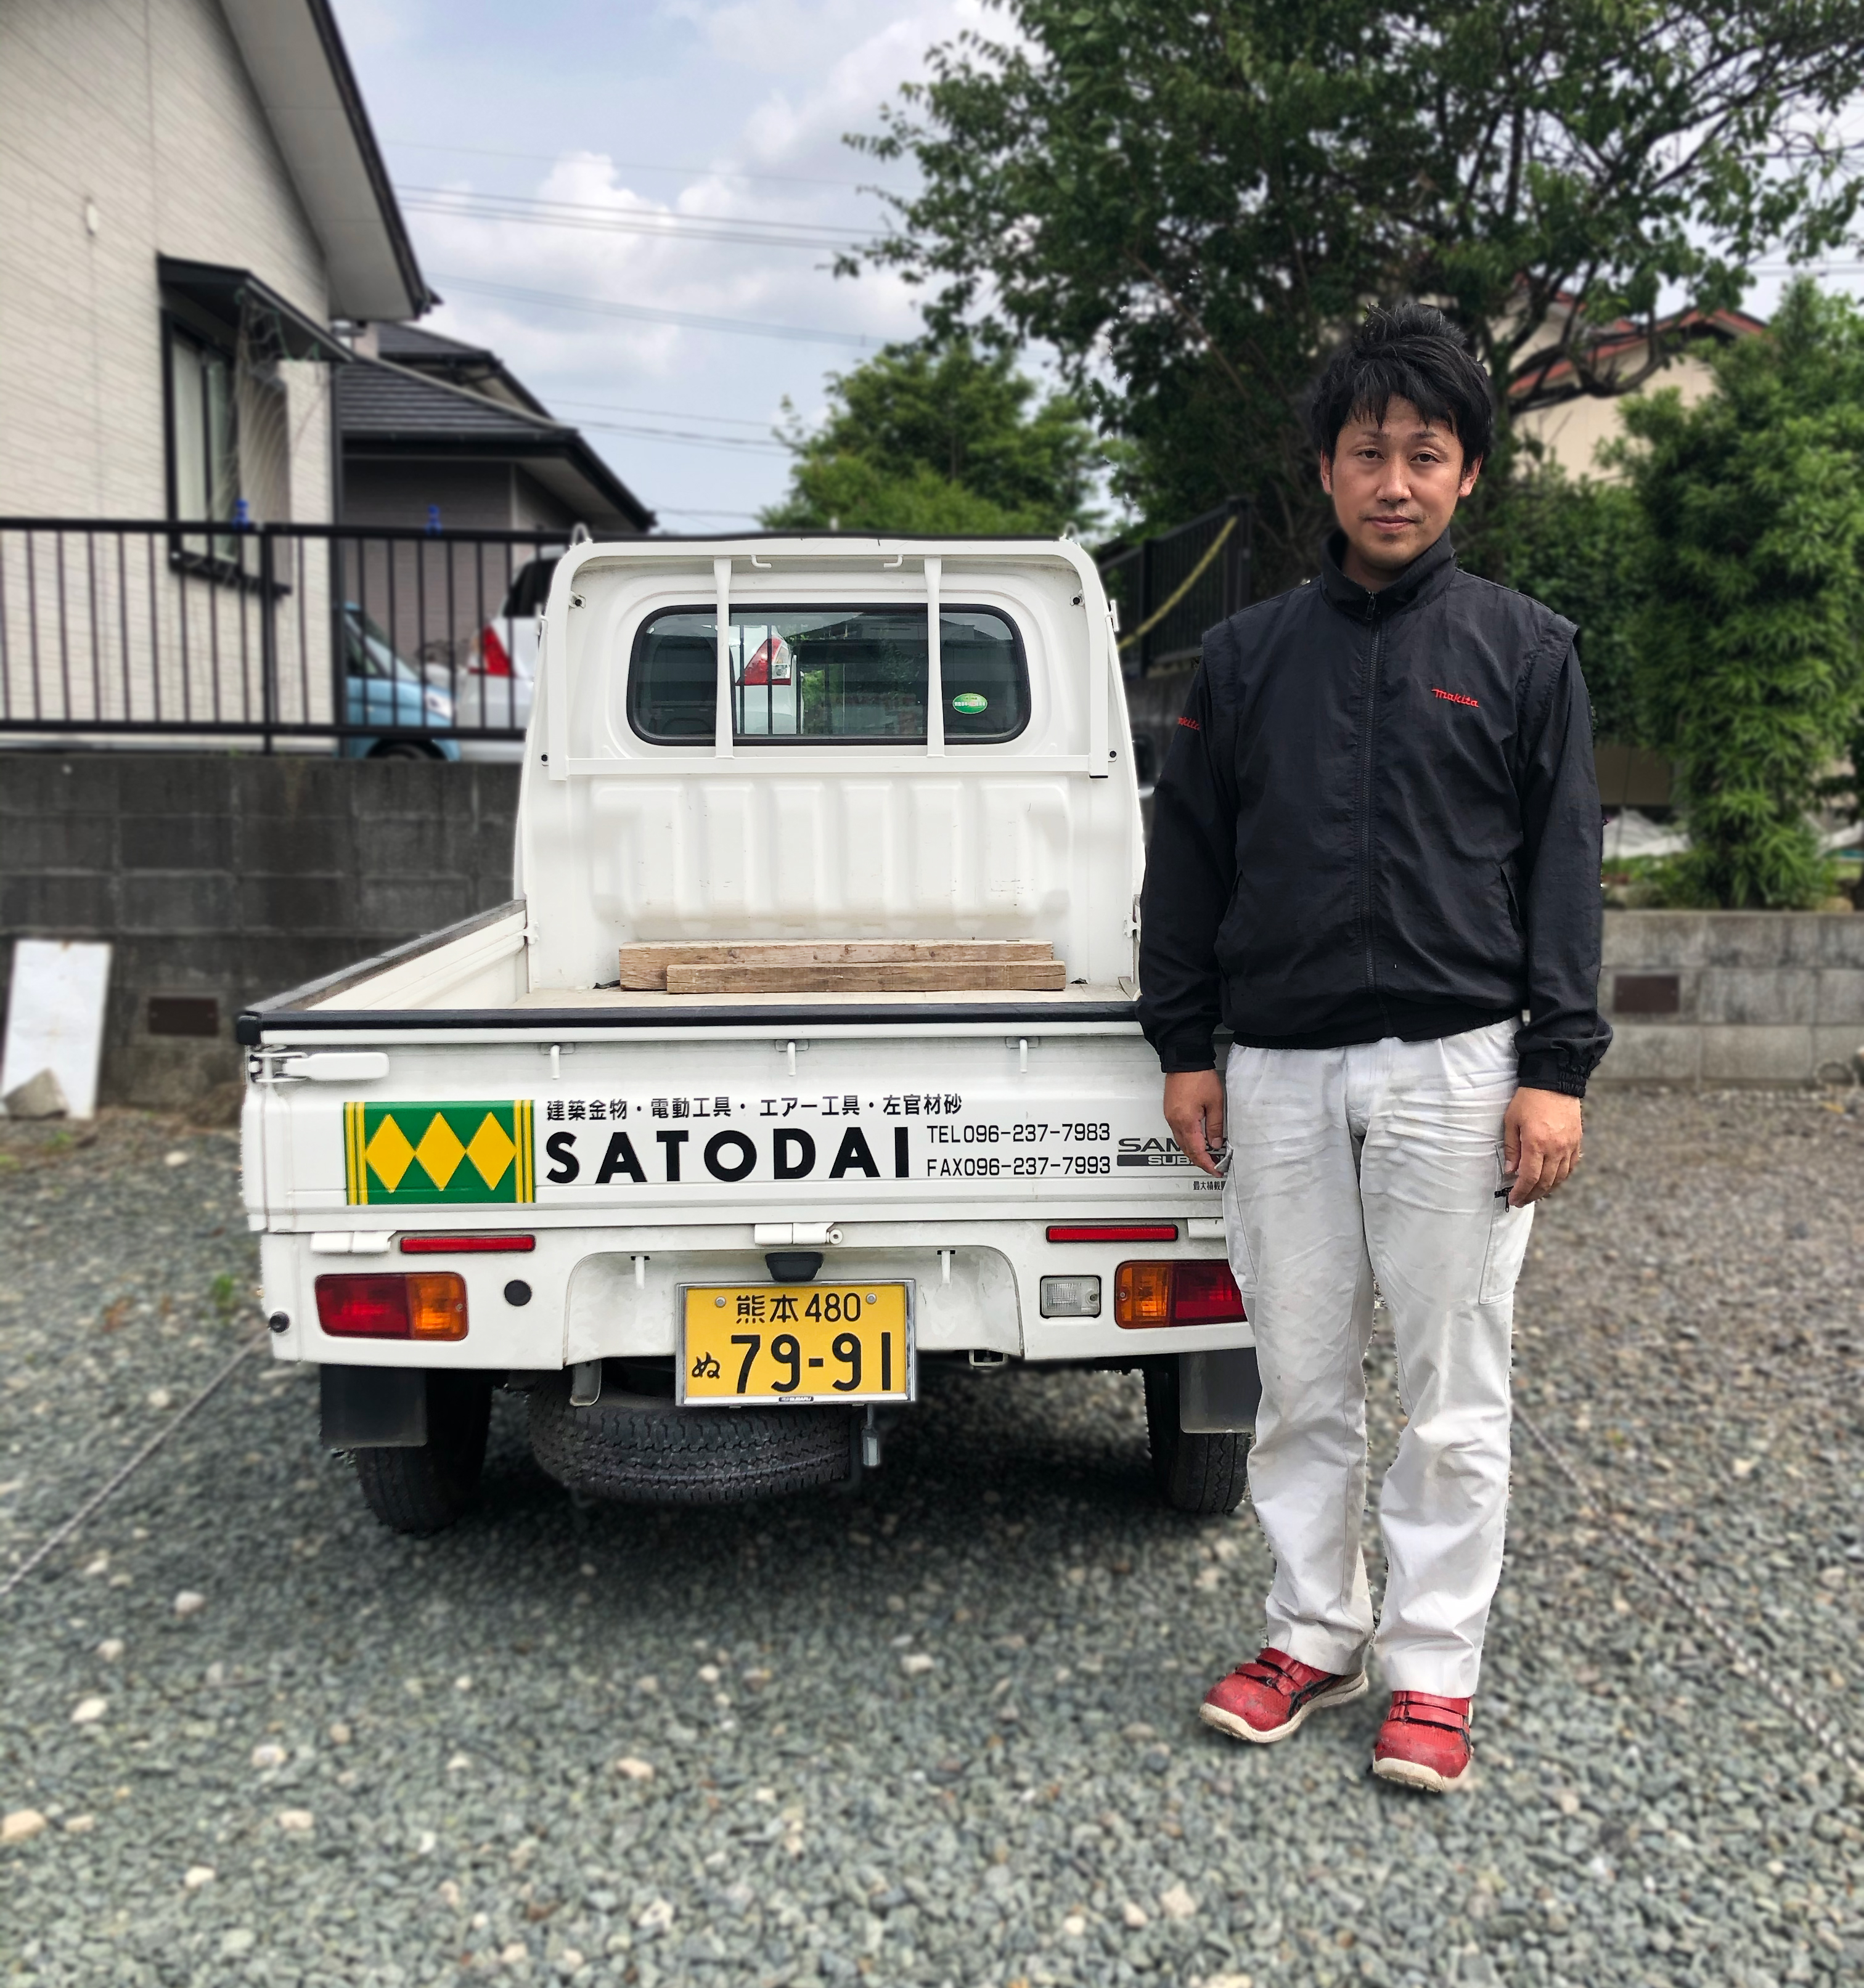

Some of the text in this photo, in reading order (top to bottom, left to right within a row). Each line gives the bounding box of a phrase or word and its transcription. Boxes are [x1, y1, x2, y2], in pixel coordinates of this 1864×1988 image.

[546, 1126, 909, 1184] SATODAI
[692, 1332, 891, 1394] ぬ 79-91
